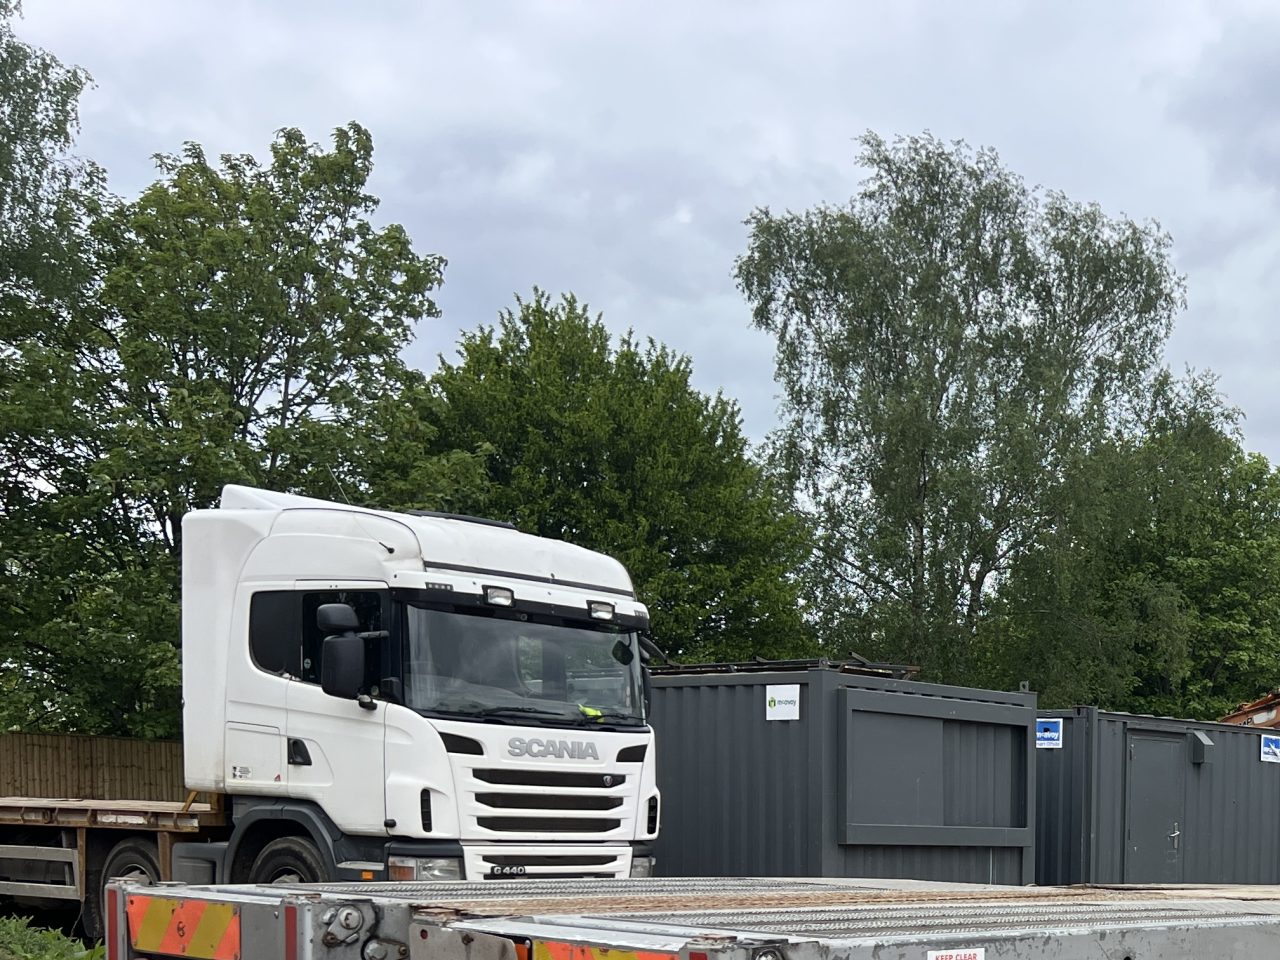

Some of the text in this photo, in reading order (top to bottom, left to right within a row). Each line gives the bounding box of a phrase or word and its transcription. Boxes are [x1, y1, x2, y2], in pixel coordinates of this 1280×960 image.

[508, 737, 600, 761] SCANIA
[493, 866, 525, 875] G 440
